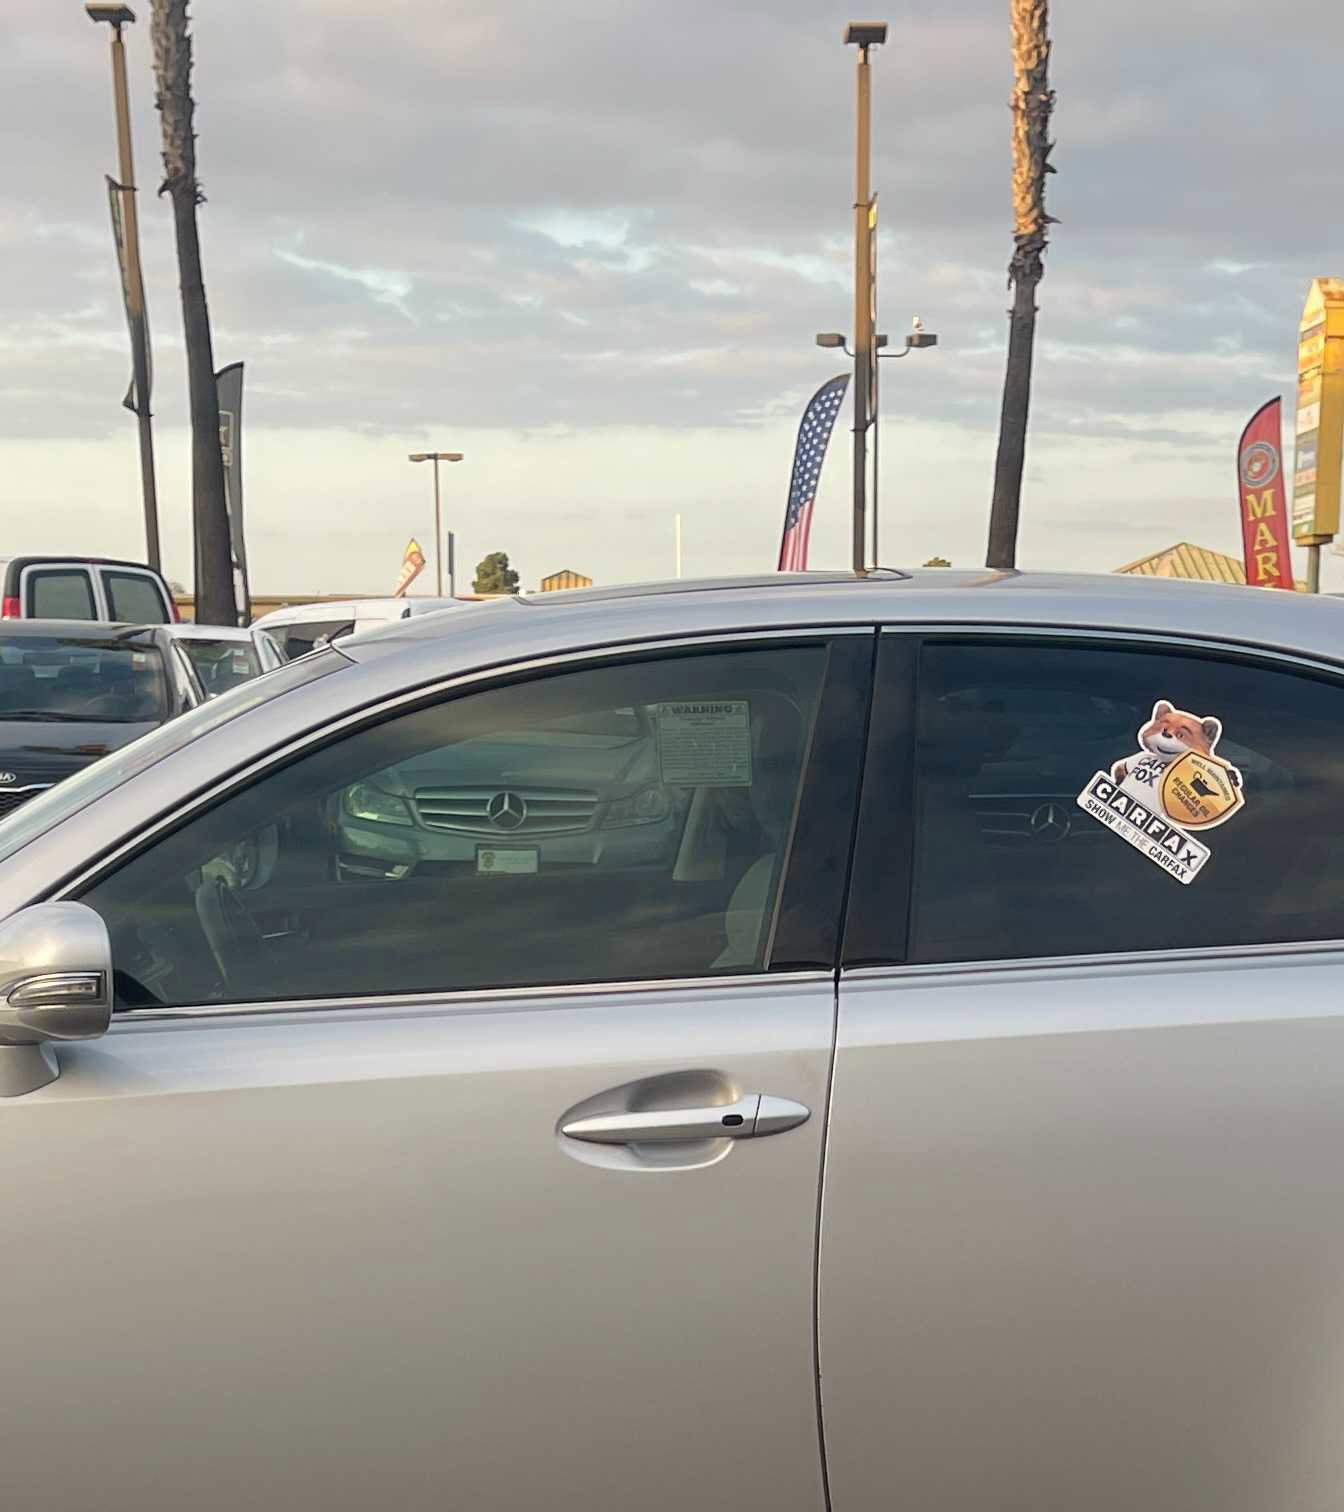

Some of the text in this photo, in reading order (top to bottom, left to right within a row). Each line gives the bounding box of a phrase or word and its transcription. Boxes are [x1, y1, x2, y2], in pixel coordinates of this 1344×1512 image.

[1246, 488, 1281, 588] MAR
[671, 704, 733, 714] WARNING
[1131, 766, 1159, 788] FOX
[1172, 777, 1201, 807] REGULAR
[1171, 787, 1199, 818] CHANGES
[1084, 799, 1116, 825] SHOW
[1148, 845, 1188, 880] CARFAX
[1095, 781, 1198, 867] CARFAX
